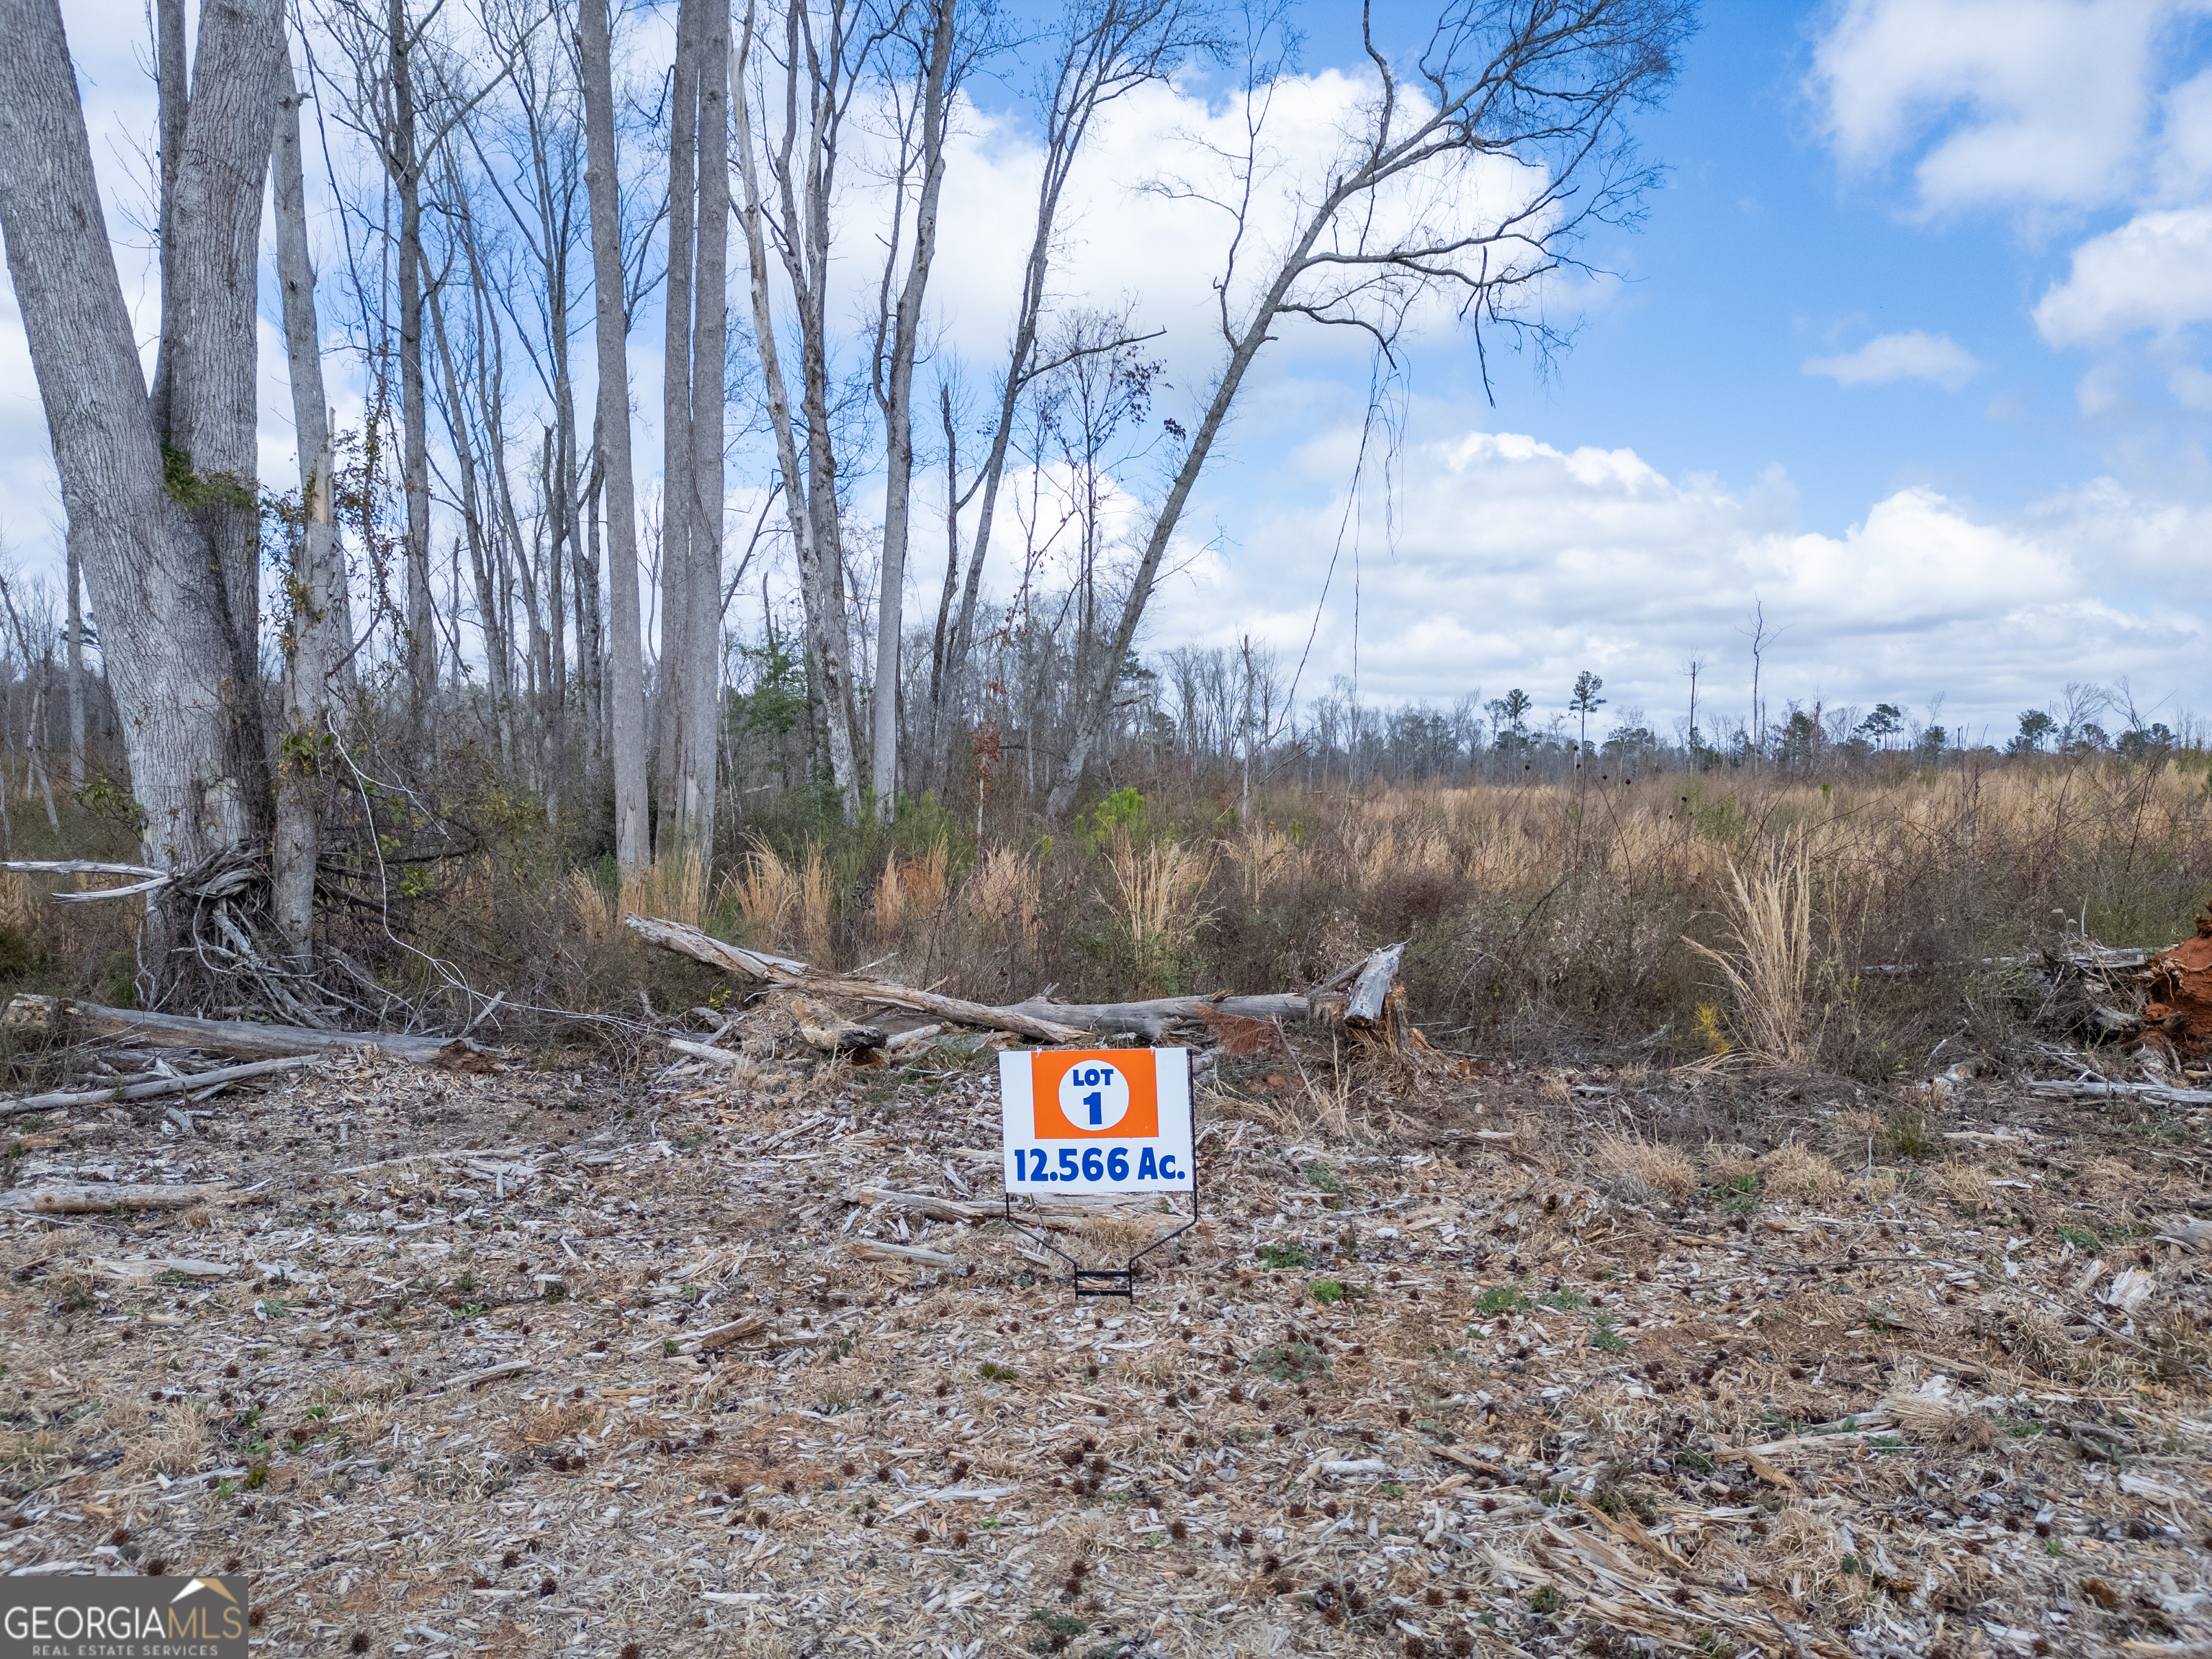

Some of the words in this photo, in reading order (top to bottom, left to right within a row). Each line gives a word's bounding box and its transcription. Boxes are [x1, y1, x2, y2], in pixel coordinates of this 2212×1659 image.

[1073, 1069, 1114, 1087] LOT
[1083, 1092, 1102, 1125] 1
[1014, 1147, 1130, 1182] 12.566
[1137, 1147, 1186, 1180] Ac.
